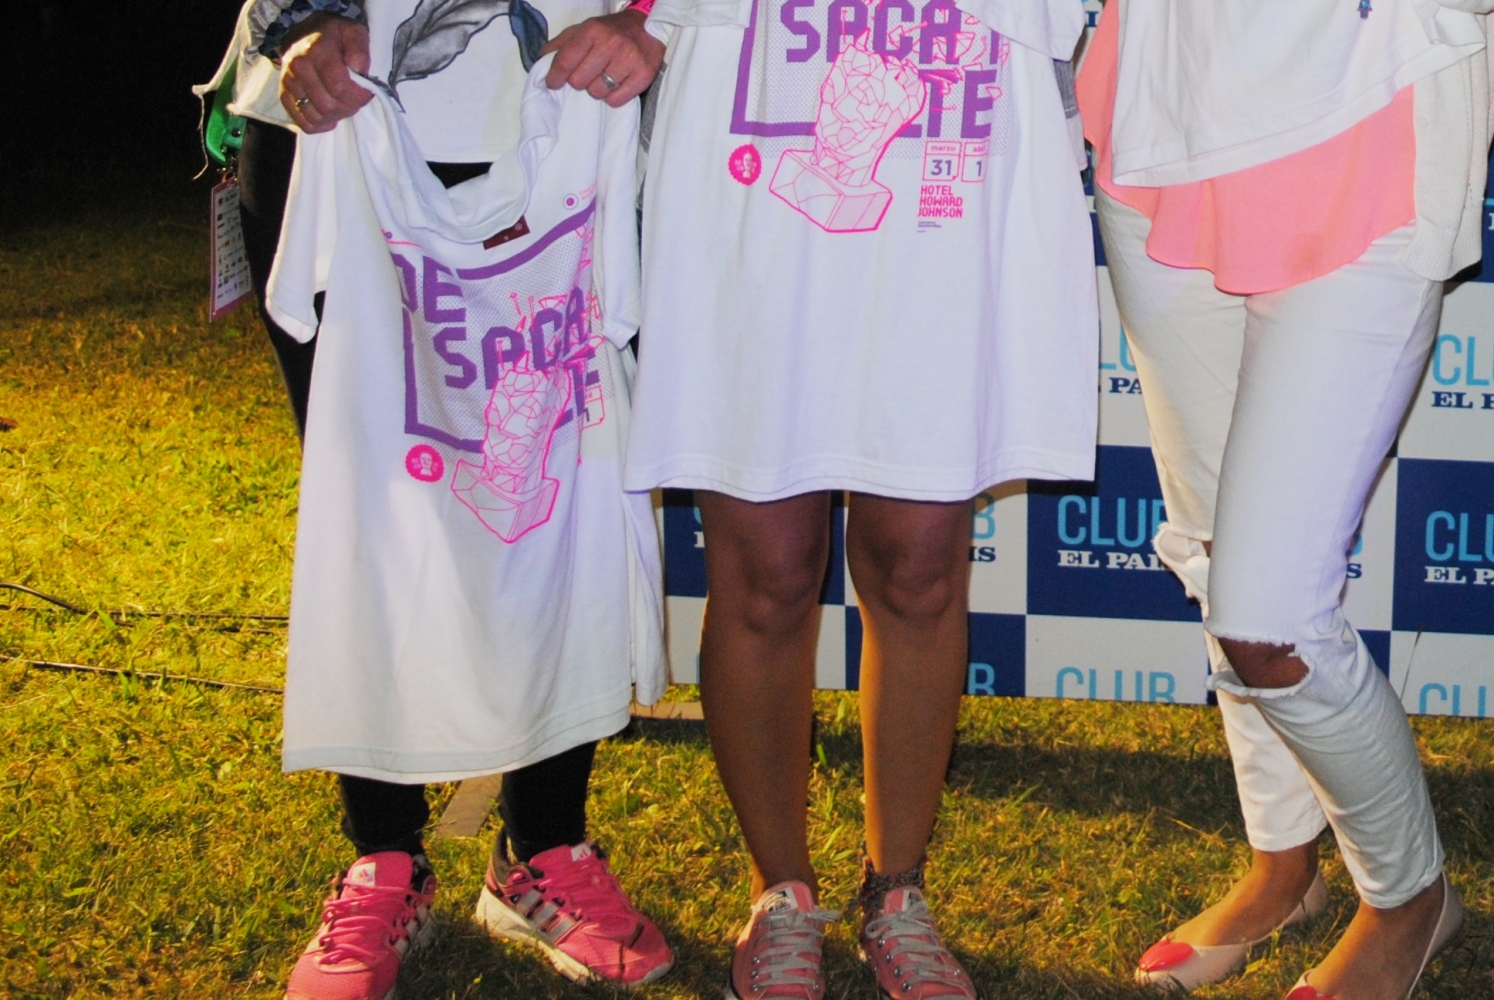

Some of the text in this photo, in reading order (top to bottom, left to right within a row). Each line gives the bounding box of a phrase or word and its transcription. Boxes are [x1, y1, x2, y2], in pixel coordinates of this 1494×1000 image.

[917, 68, 998, 139] TE
[930, 159, 953, 176] 31
[920, 185, 954, 197] HOTEL
[918, 195, 964, 207] HOWARD
[917, 206, 964, 218] JOHNSON
[1431, 390, 1474, 409] EL
[1057, 550, 1100, 568] EL
[1424, 566, 1467, 585] EL
